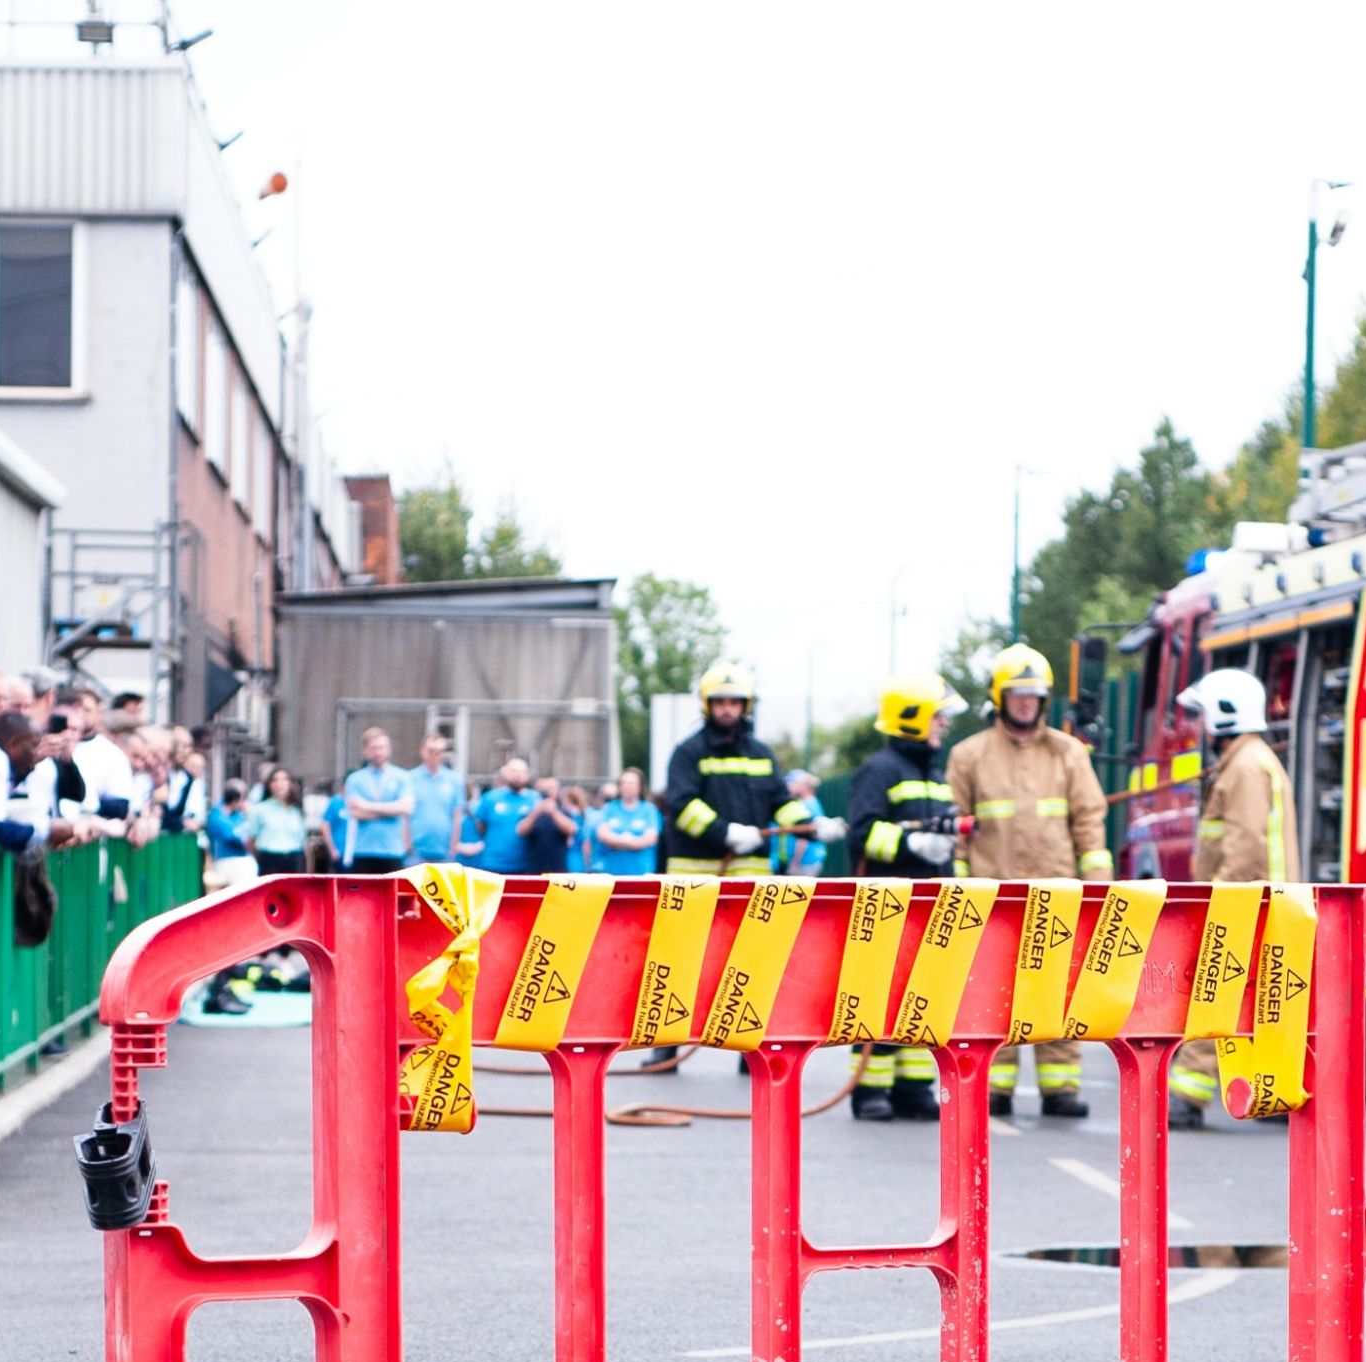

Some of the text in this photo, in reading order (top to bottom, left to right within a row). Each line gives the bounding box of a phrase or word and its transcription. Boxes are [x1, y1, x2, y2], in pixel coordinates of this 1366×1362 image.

[850, 905, 861, 941] hazard
[925, 910, 943, 945] hazard
[1020, 887, 1038, 970] Chemical hazard
[1029, 890, 1051, 970] DANGER
[1086, 893, 1116, 971] Chemical hazard
[1095, 898, 1129, 975] DANGER
[1194, 922, 1215, 1002] Chemical hazard
[507, 935, 542, 1018] Chemical hazard
[516, 940, 556, 1022] DANGER
[641, 961, 656, 1007] Chemical
[716, 966, 735, 1014] Chemical
[1203, 925, 1227, 1003] DANGER
[1257, 943, 1270, 1024] Chemical hazard
[1267, 945, 1284, 1023] DANGER
[640, 964, 670, 1047] DANGER
[711, 971, 749, 1047] DANGER
[424, 1049, 447, 1097] Chemical
[425, 1053, 461, 1131] DANGER
